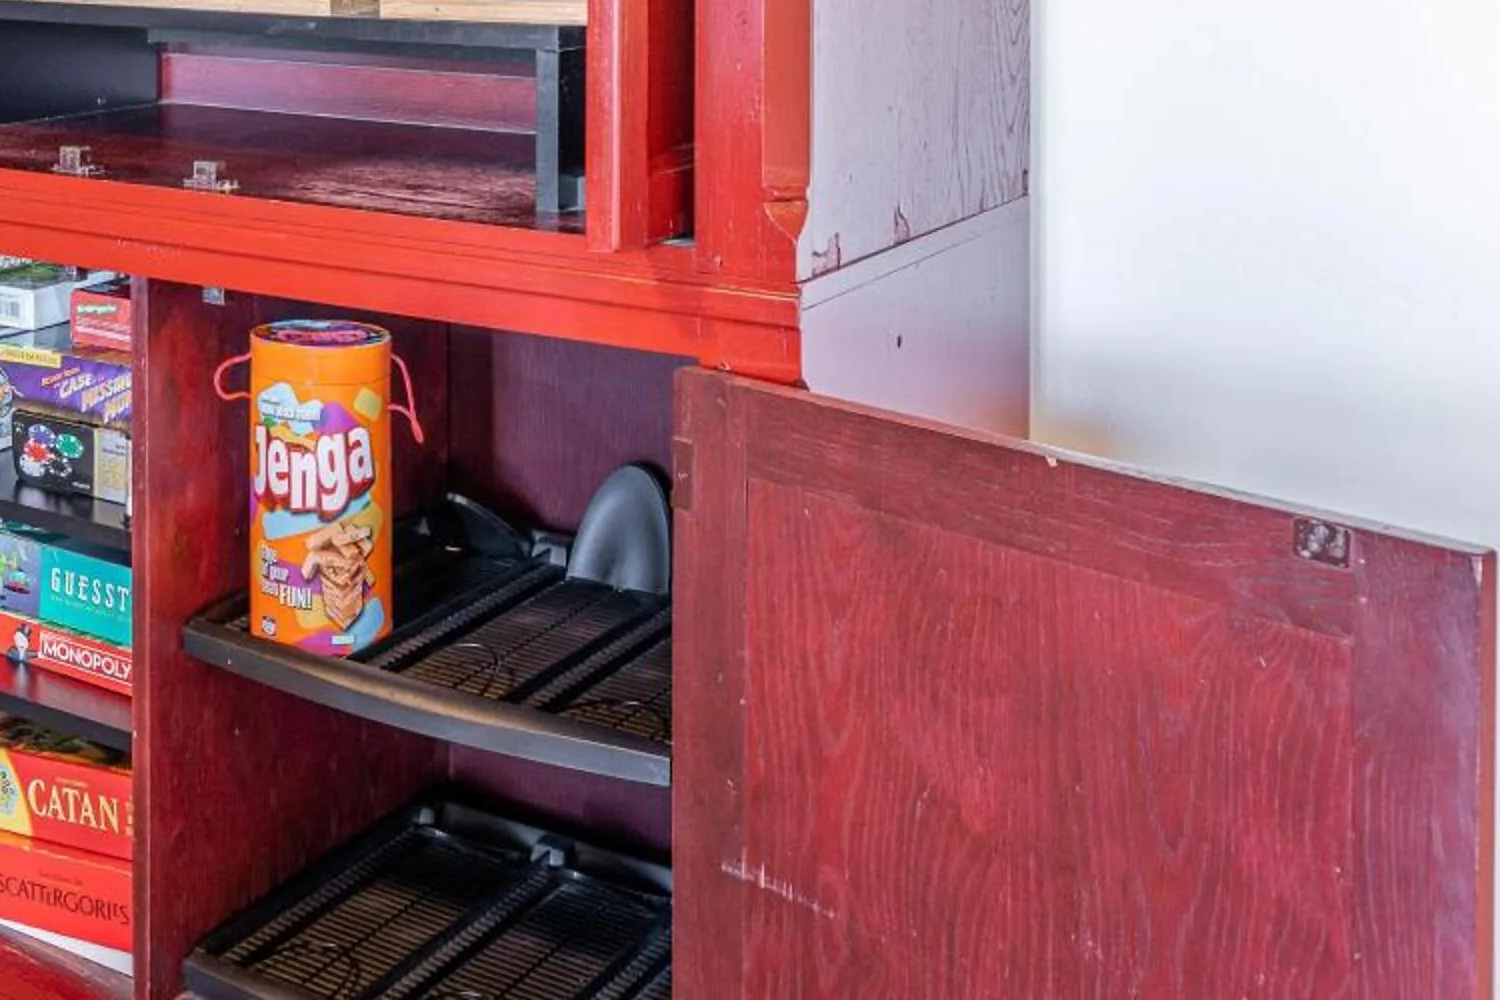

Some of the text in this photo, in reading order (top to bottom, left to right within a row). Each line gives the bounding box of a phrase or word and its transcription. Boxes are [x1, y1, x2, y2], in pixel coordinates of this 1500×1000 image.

[253, 426, 373, 512] Jenga
[51, 567, 132, 612] GUESST
[43, 640, 132, 681] MONOPOLY
[28, 779, 120, 835] CATAN
